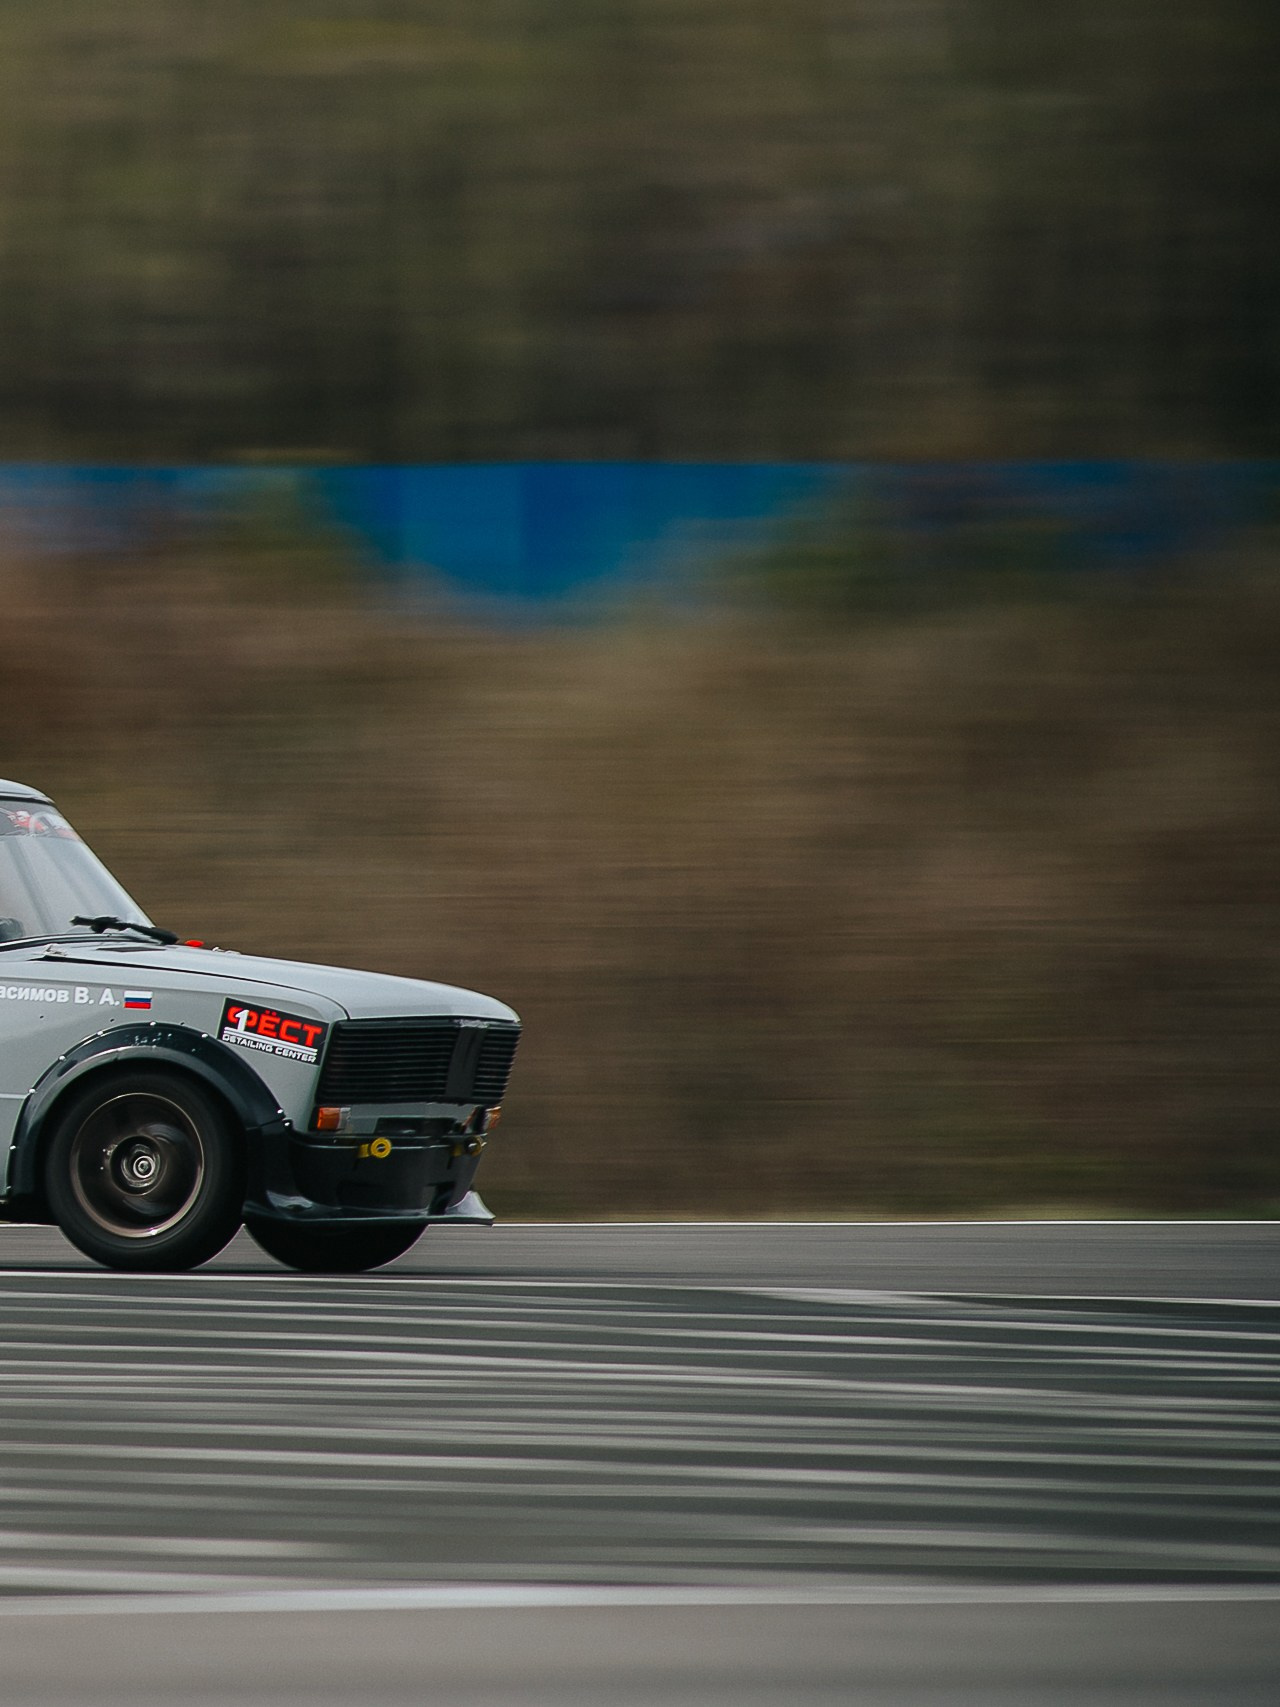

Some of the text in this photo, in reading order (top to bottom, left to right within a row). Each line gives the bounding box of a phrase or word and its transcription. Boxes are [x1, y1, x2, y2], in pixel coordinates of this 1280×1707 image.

[74, 986, 95, 1005] В.
[98, 987, 120, 1006] А.
[222, 1033, 317, 1063] DETAILING CENTER
